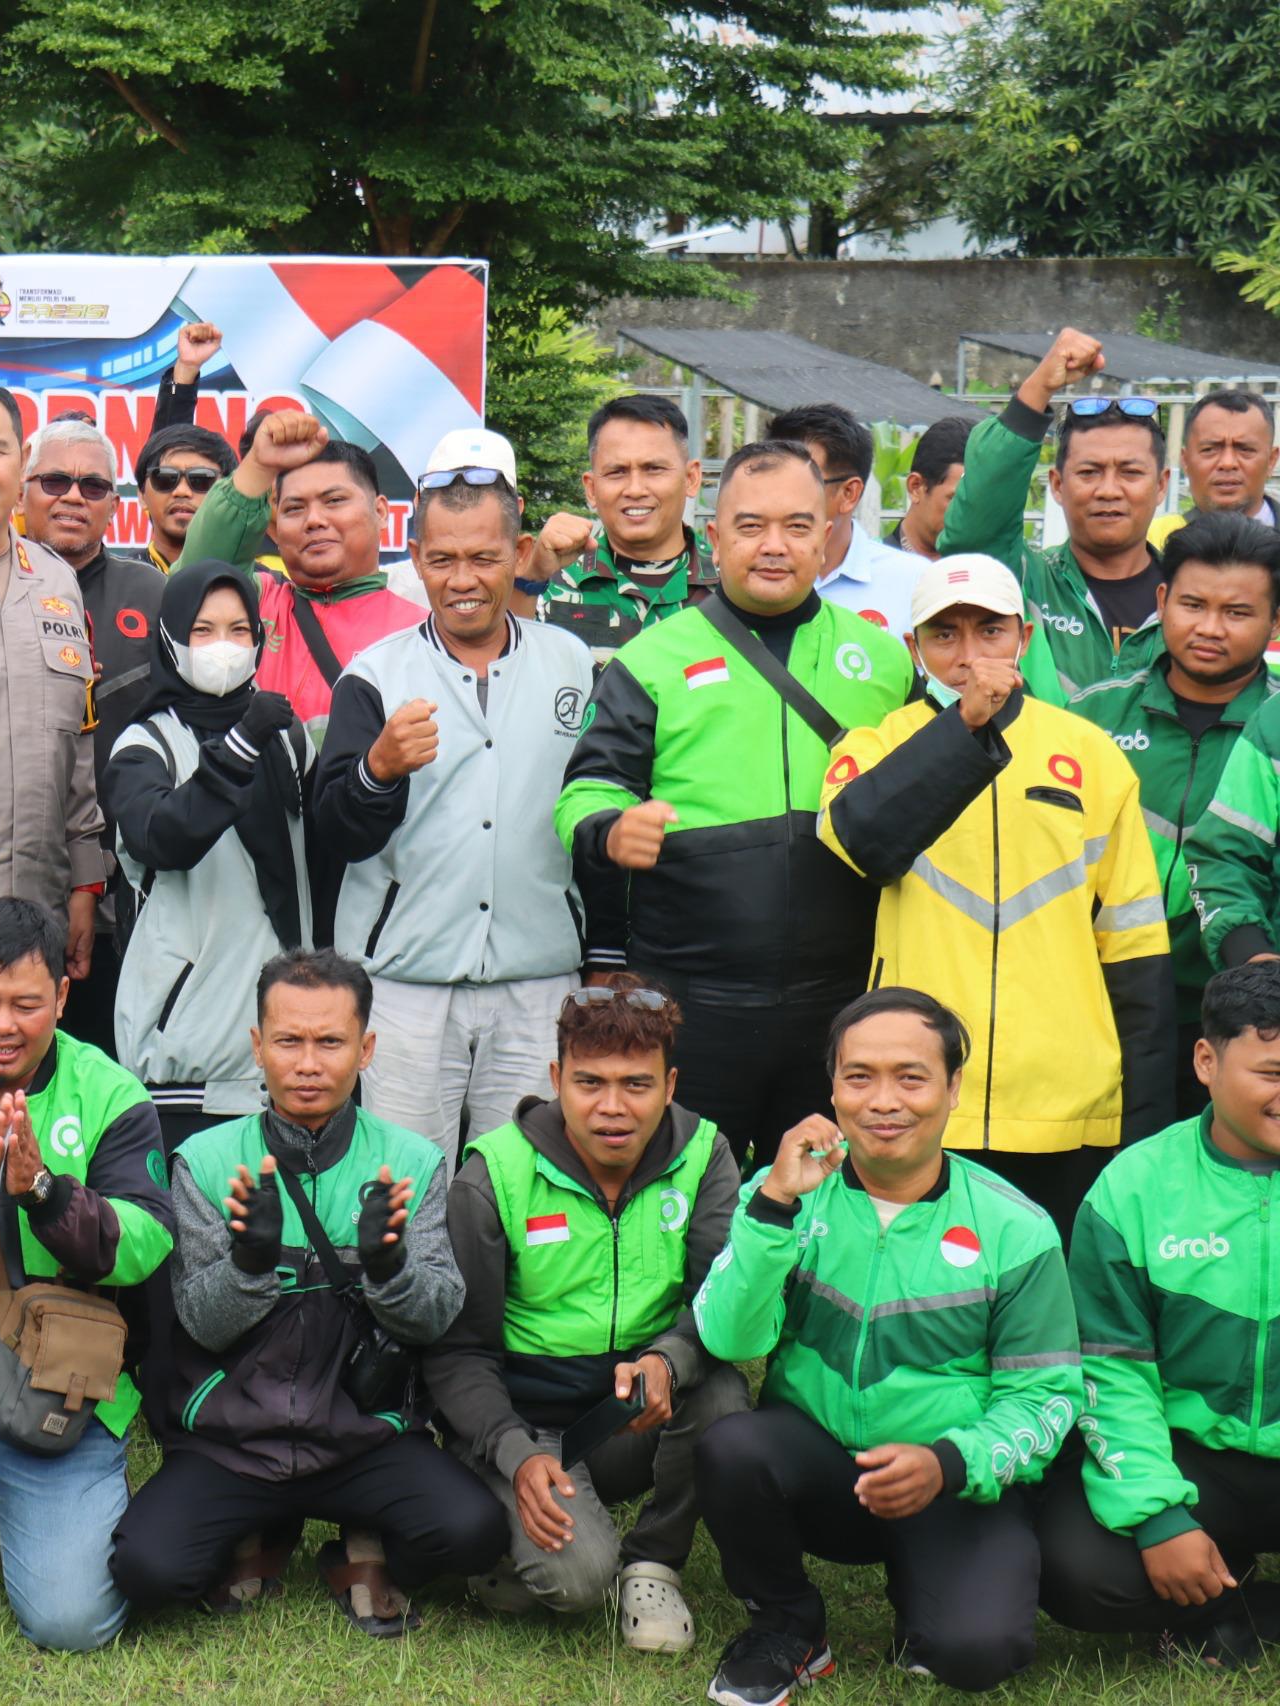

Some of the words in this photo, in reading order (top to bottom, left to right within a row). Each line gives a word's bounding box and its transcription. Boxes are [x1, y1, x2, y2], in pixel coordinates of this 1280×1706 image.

[42, 621, 84, 640] POLRI
[1104, 729, 1150, 750] rab
[1159, 1231, 1230, 1260] Grab
